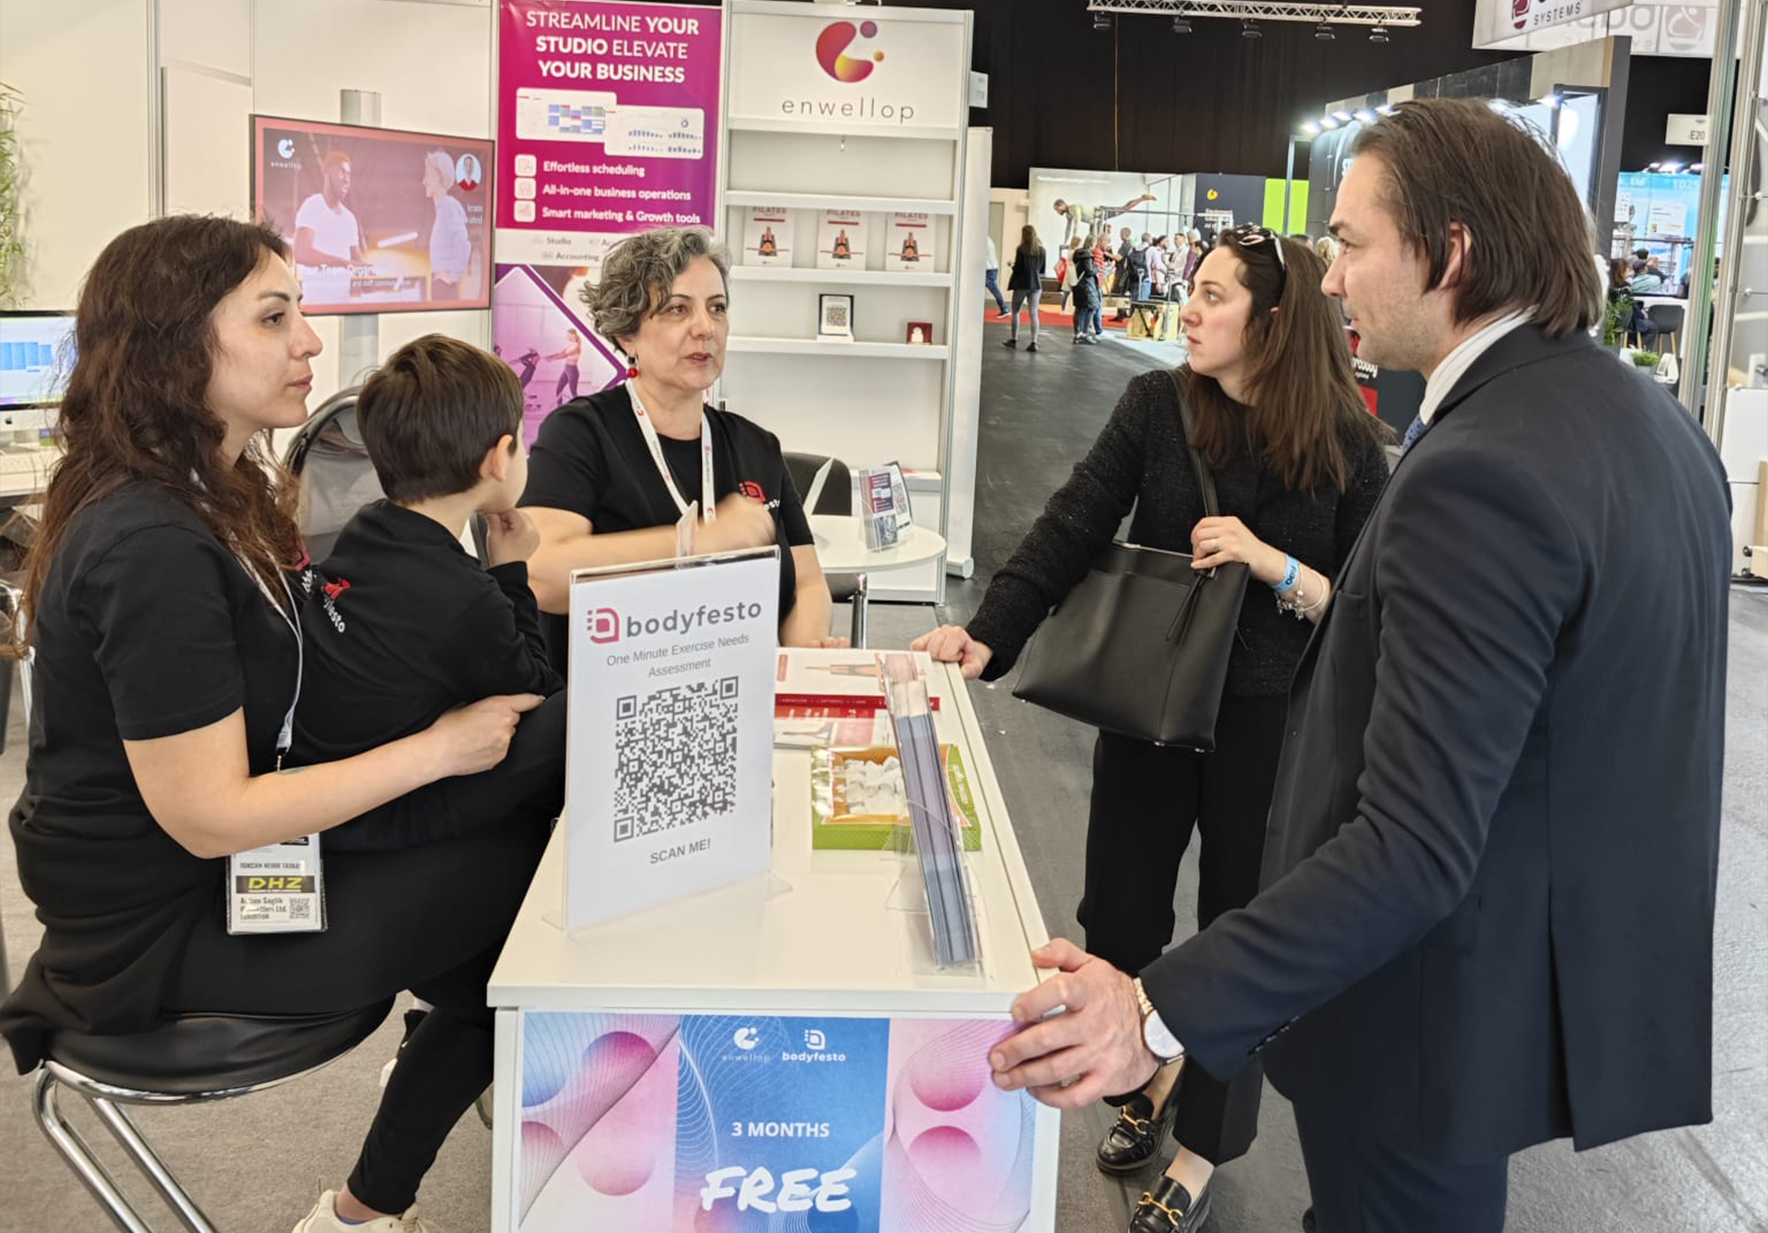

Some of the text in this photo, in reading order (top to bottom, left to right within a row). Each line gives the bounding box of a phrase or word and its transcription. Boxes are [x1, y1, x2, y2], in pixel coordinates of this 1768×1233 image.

[526, 11, 700, 35] STREAMLINE YOUR
[1533, 2, 1581, 26] SYSTEMS
[536, 36, 688, 59] STUDIO ELEVATE
[538, 60, 685, 83] YOUR BUSINESS
[782, 96, 914, 124] enwellop
[543, 160, 645, 178] Effortless scheduling
[542, 184, 691, 201] All-in-one business operations
[542, 206, 700, 224] Smart marketing & Growth tools
[627, 601, 762, 639] bodyfesto
[607, 633, 750, 667] One Minute Exercise Needs
[647, 658, 711, 678] Assessment
[650, 837, 711, 864] SCAN ME!
[248, 877, 303, 889] DHZ
[782, 1051, 846, 1063] bodyfesto
[731, 1122, 830, 1138] 3 MONTHS
[700, 1166, 857, 1214] FREE
